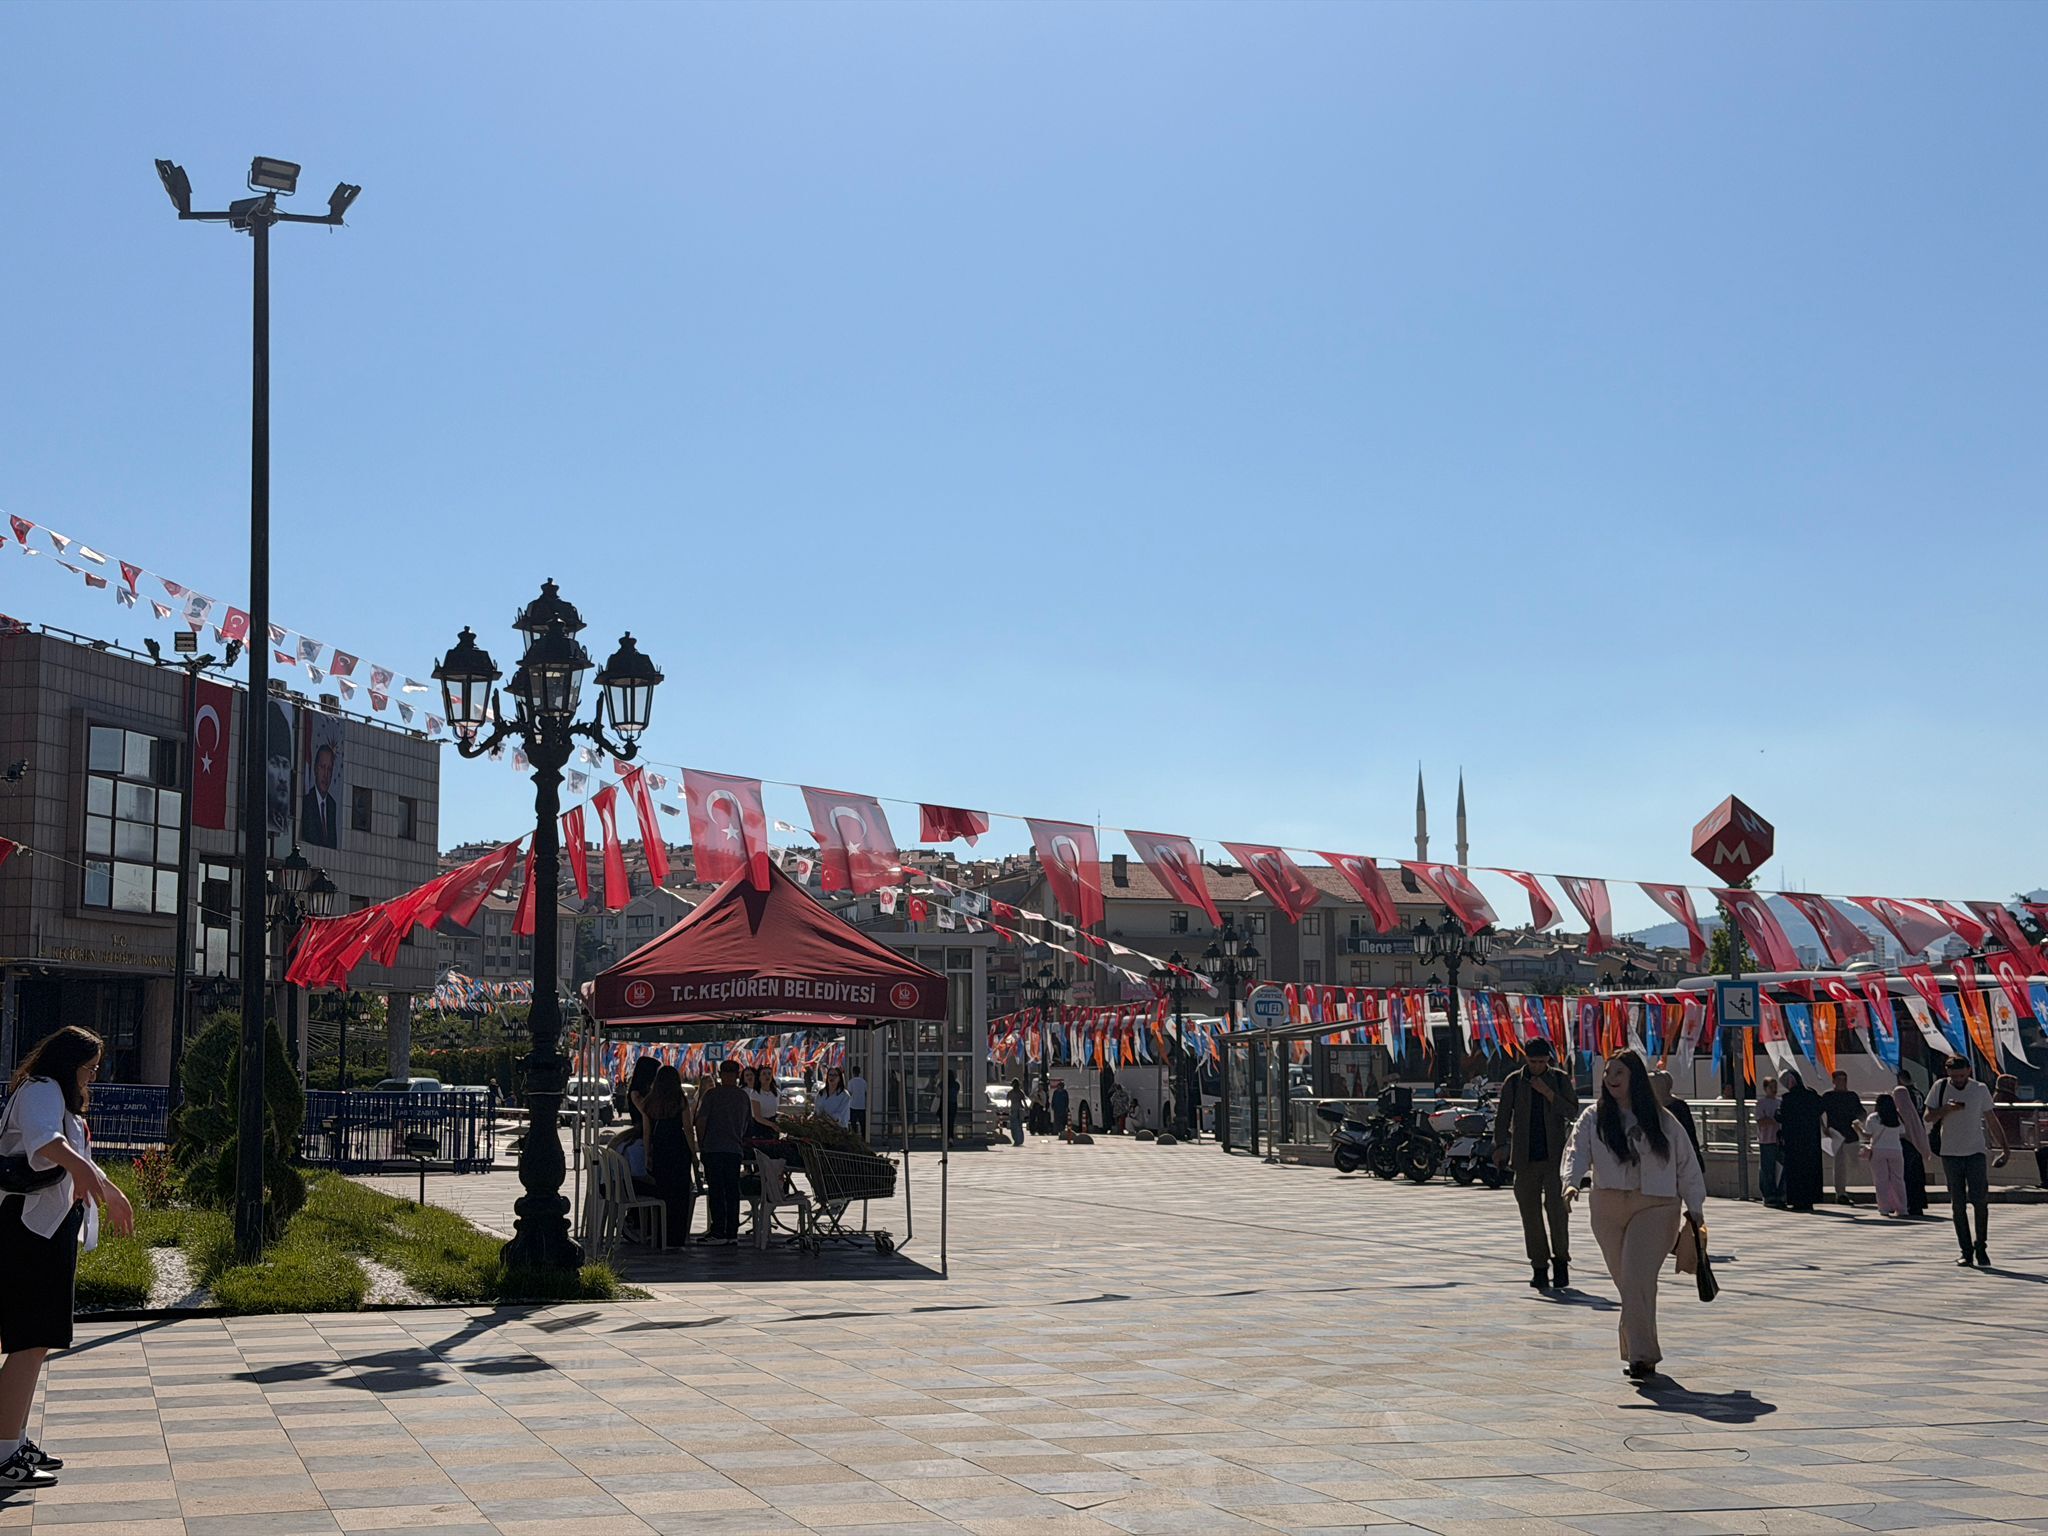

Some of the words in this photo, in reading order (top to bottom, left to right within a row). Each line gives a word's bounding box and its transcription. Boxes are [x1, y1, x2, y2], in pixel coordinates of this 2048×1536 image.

[1736, 809, 1768, 835] M
[1713, 840, 1752, 865] M
[1359, 939, 1393, 953] Merve
[783, 979, 876, 1004] BELEDİYESİ
